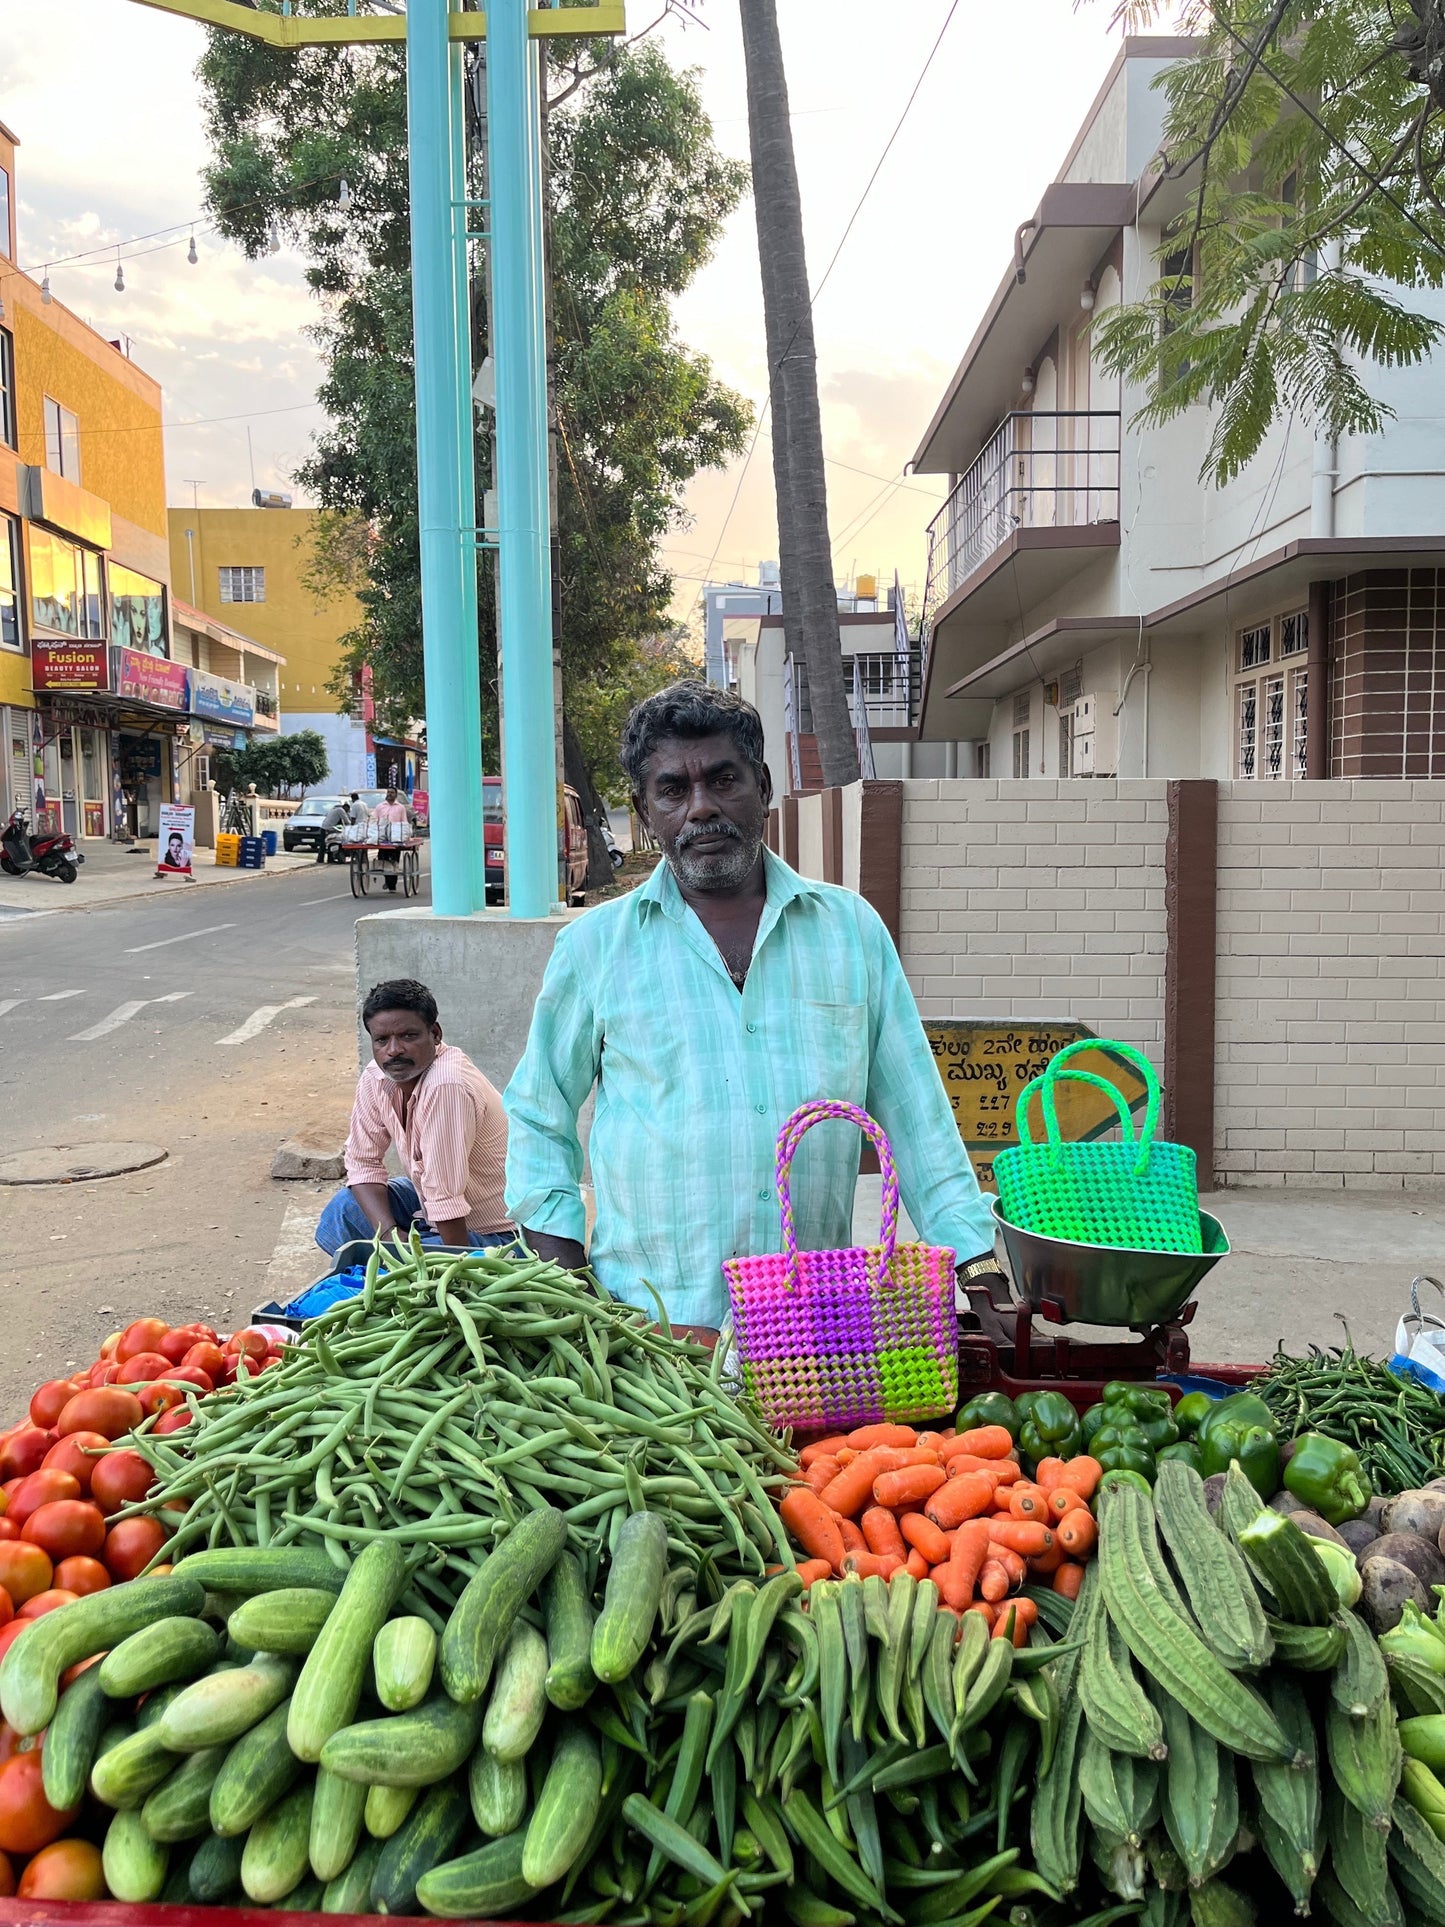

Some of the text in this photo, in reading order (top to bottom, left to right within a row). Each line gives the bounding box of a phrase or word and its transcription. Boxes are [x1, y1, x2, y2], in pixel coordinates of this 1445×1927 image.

[48, 651, 95, 663] Fusion
[929, 1034, 971, 1056] ಕುಲಂ
[983, 1033, 1022, 1055] 2ನೇ
[947, 1058, 1007, 1091] ಮುಖ್ಯ
[980, 1095, 1010, 1110] 227
